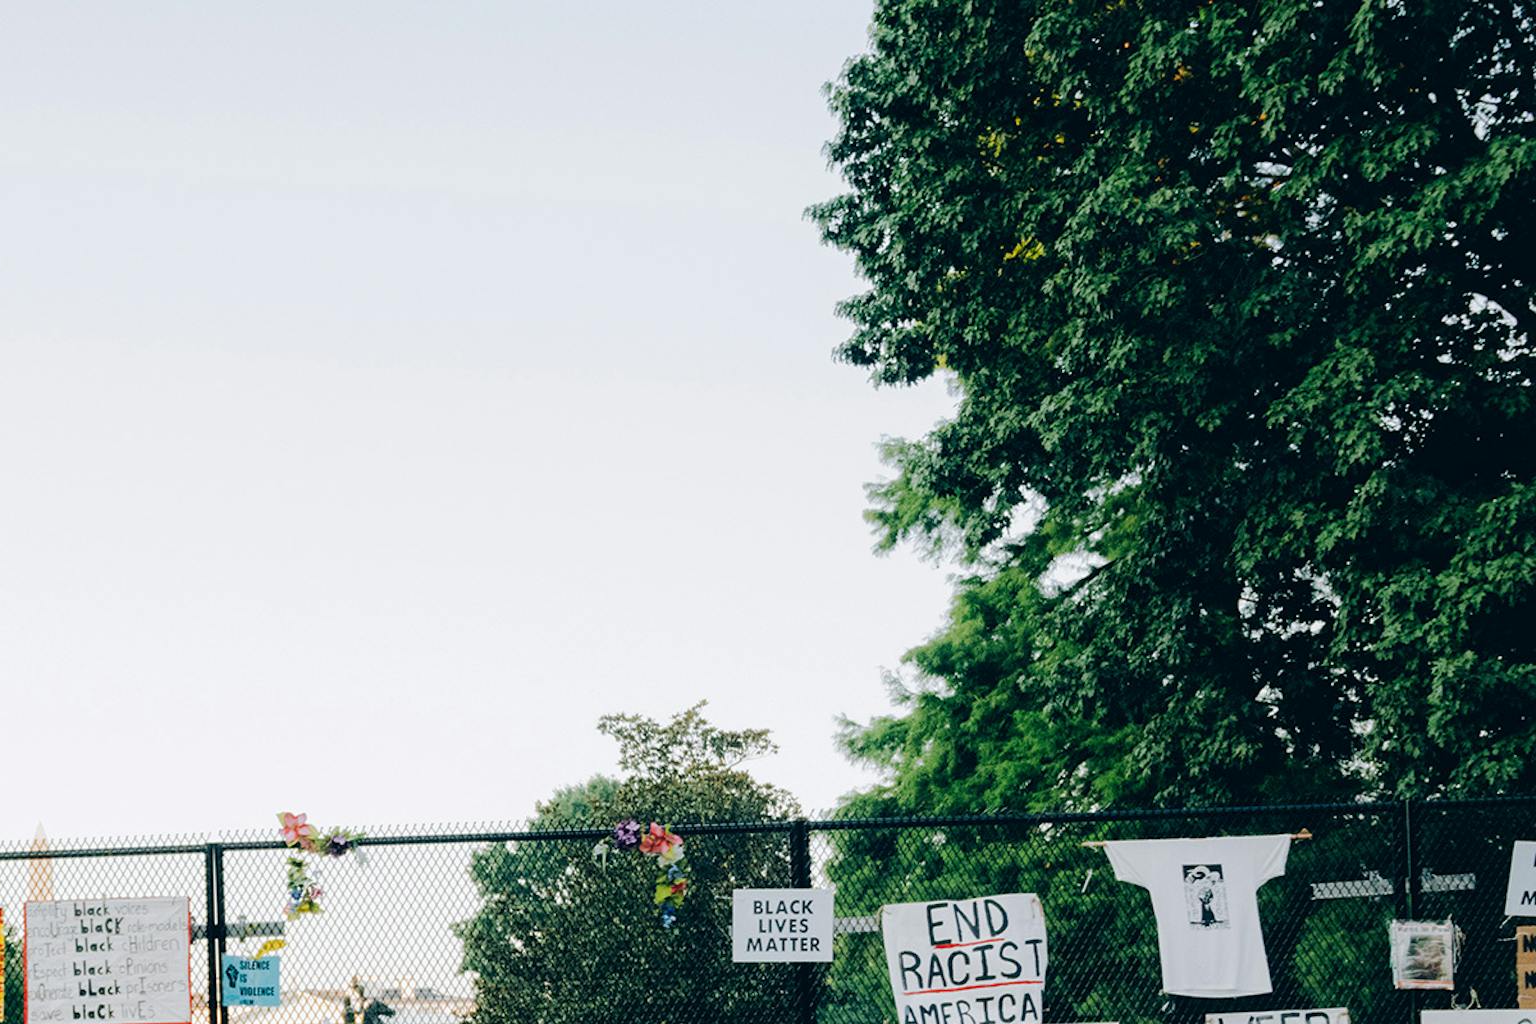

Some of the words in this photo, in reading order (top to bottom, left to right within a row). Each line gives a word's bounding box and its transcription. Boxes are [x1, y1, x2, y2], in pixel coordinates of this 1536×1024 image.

[74, 902, 110, 917] black
[753, 900, 814, 915] BLACK
[758, 919, 809, 933] LIVES
[926, 899, 1009, 946] END
[75, 936, 114, 953] black
[746, 938, 820, 952] MATTER
[73, 959, 113, 976] black
[239, 961, 270, 970] SILENCE
[898, 939, 1043, 990] RACIST
[239, 974, 247, 983] IS
[239, 986, 275, 996] VIOLENCE
